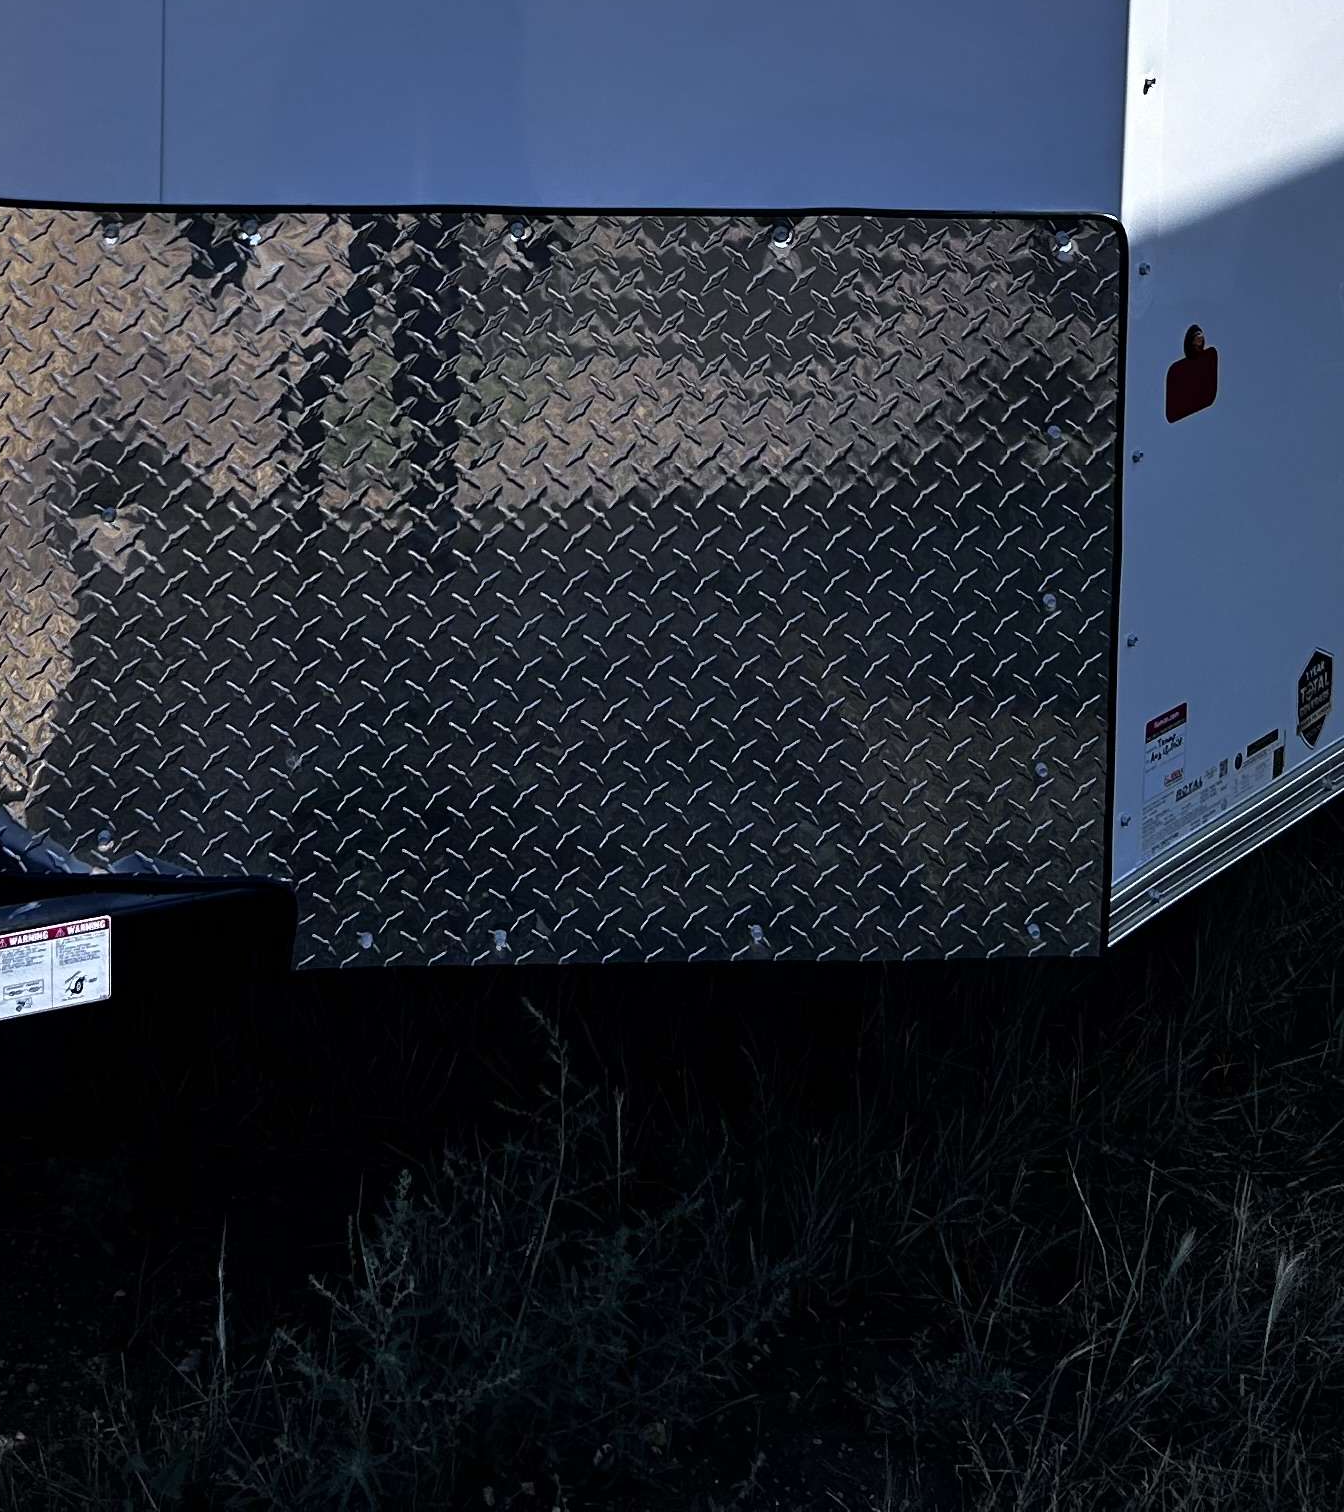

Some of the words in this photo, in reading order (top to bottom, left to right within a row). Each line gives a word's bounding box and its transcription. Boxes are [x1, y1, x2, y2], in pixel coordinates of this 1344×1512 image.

[1300, 671, 1330, 705] TOTAL
[67, 919, 106, 935] WARNING
[9, 931, 48, 946] WARNING
